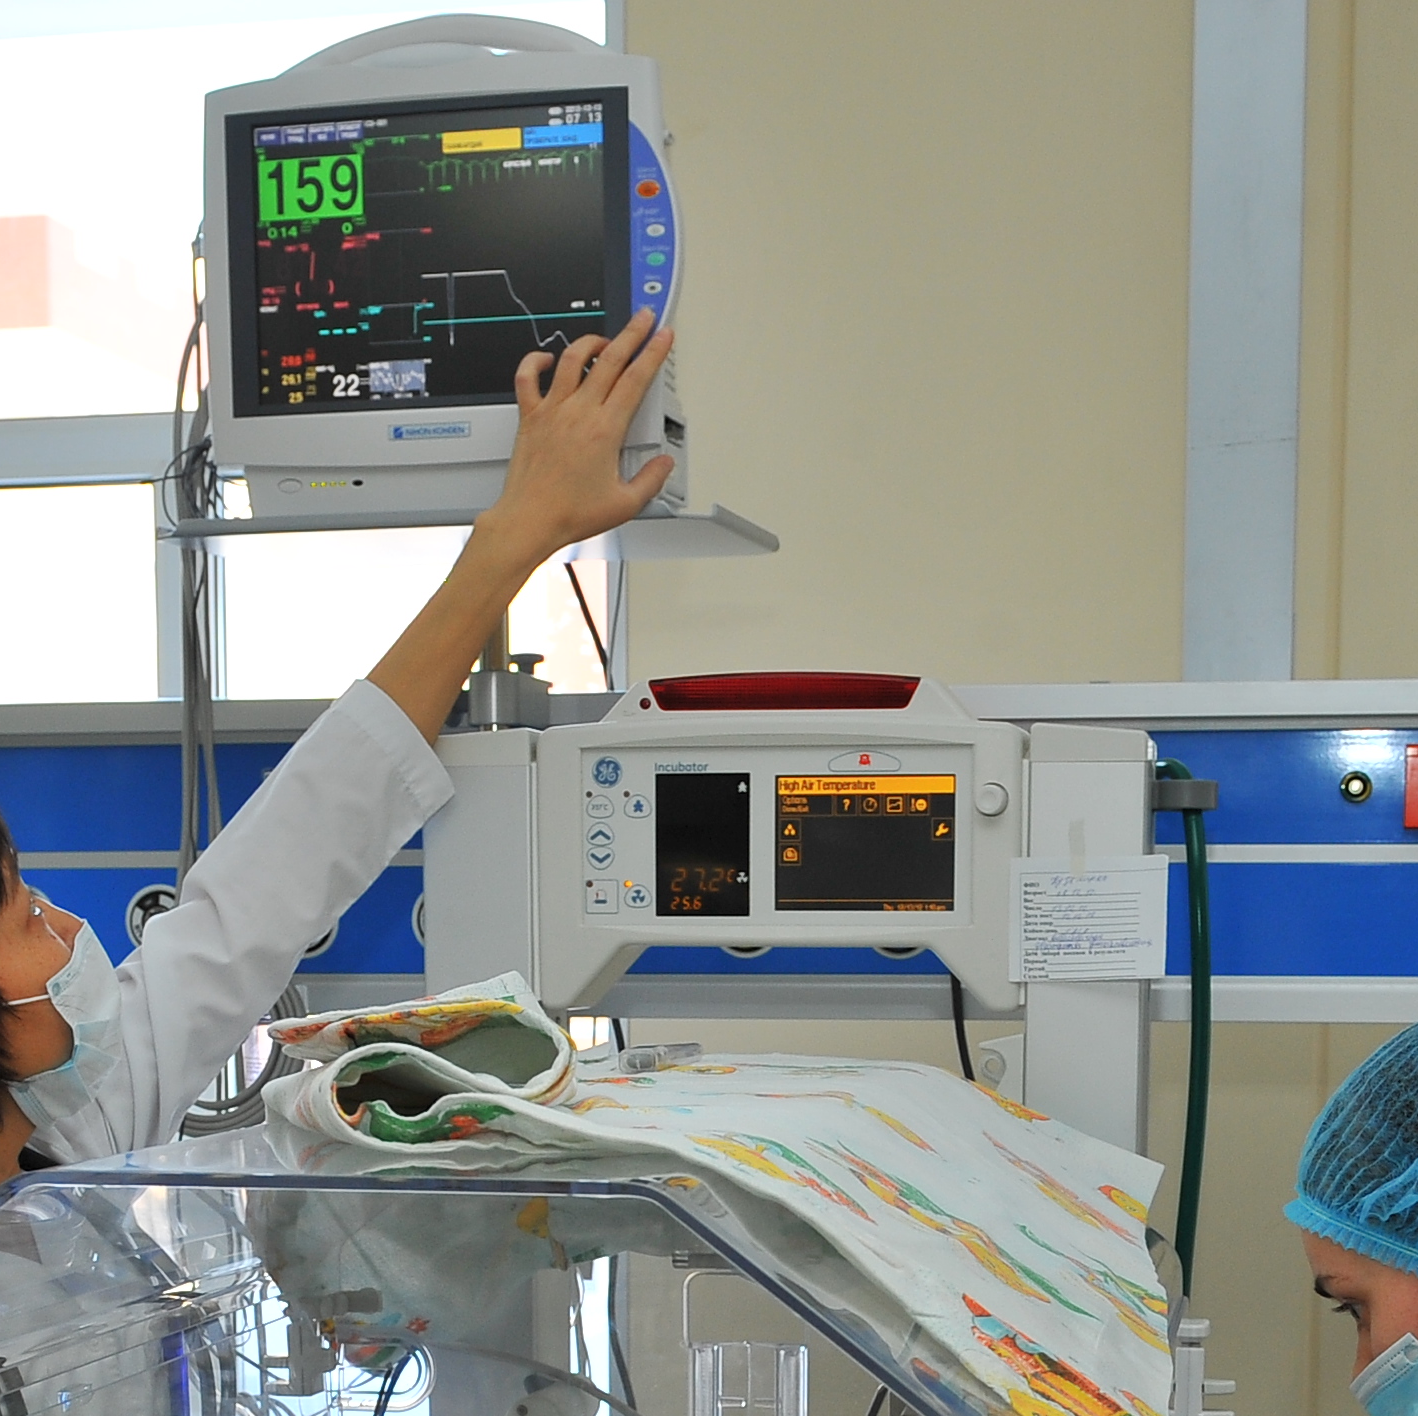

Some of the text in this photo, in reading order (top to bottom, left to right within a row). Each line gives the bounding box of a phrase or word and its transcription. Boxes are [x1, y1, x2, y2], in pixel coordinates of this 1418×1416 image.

[267, 156, 359, 215] 159
[332, 374, 361, 397] 22
[654, 762, 709, 772] Incubator
[781, 780, 876, 792] High Air Temperature
